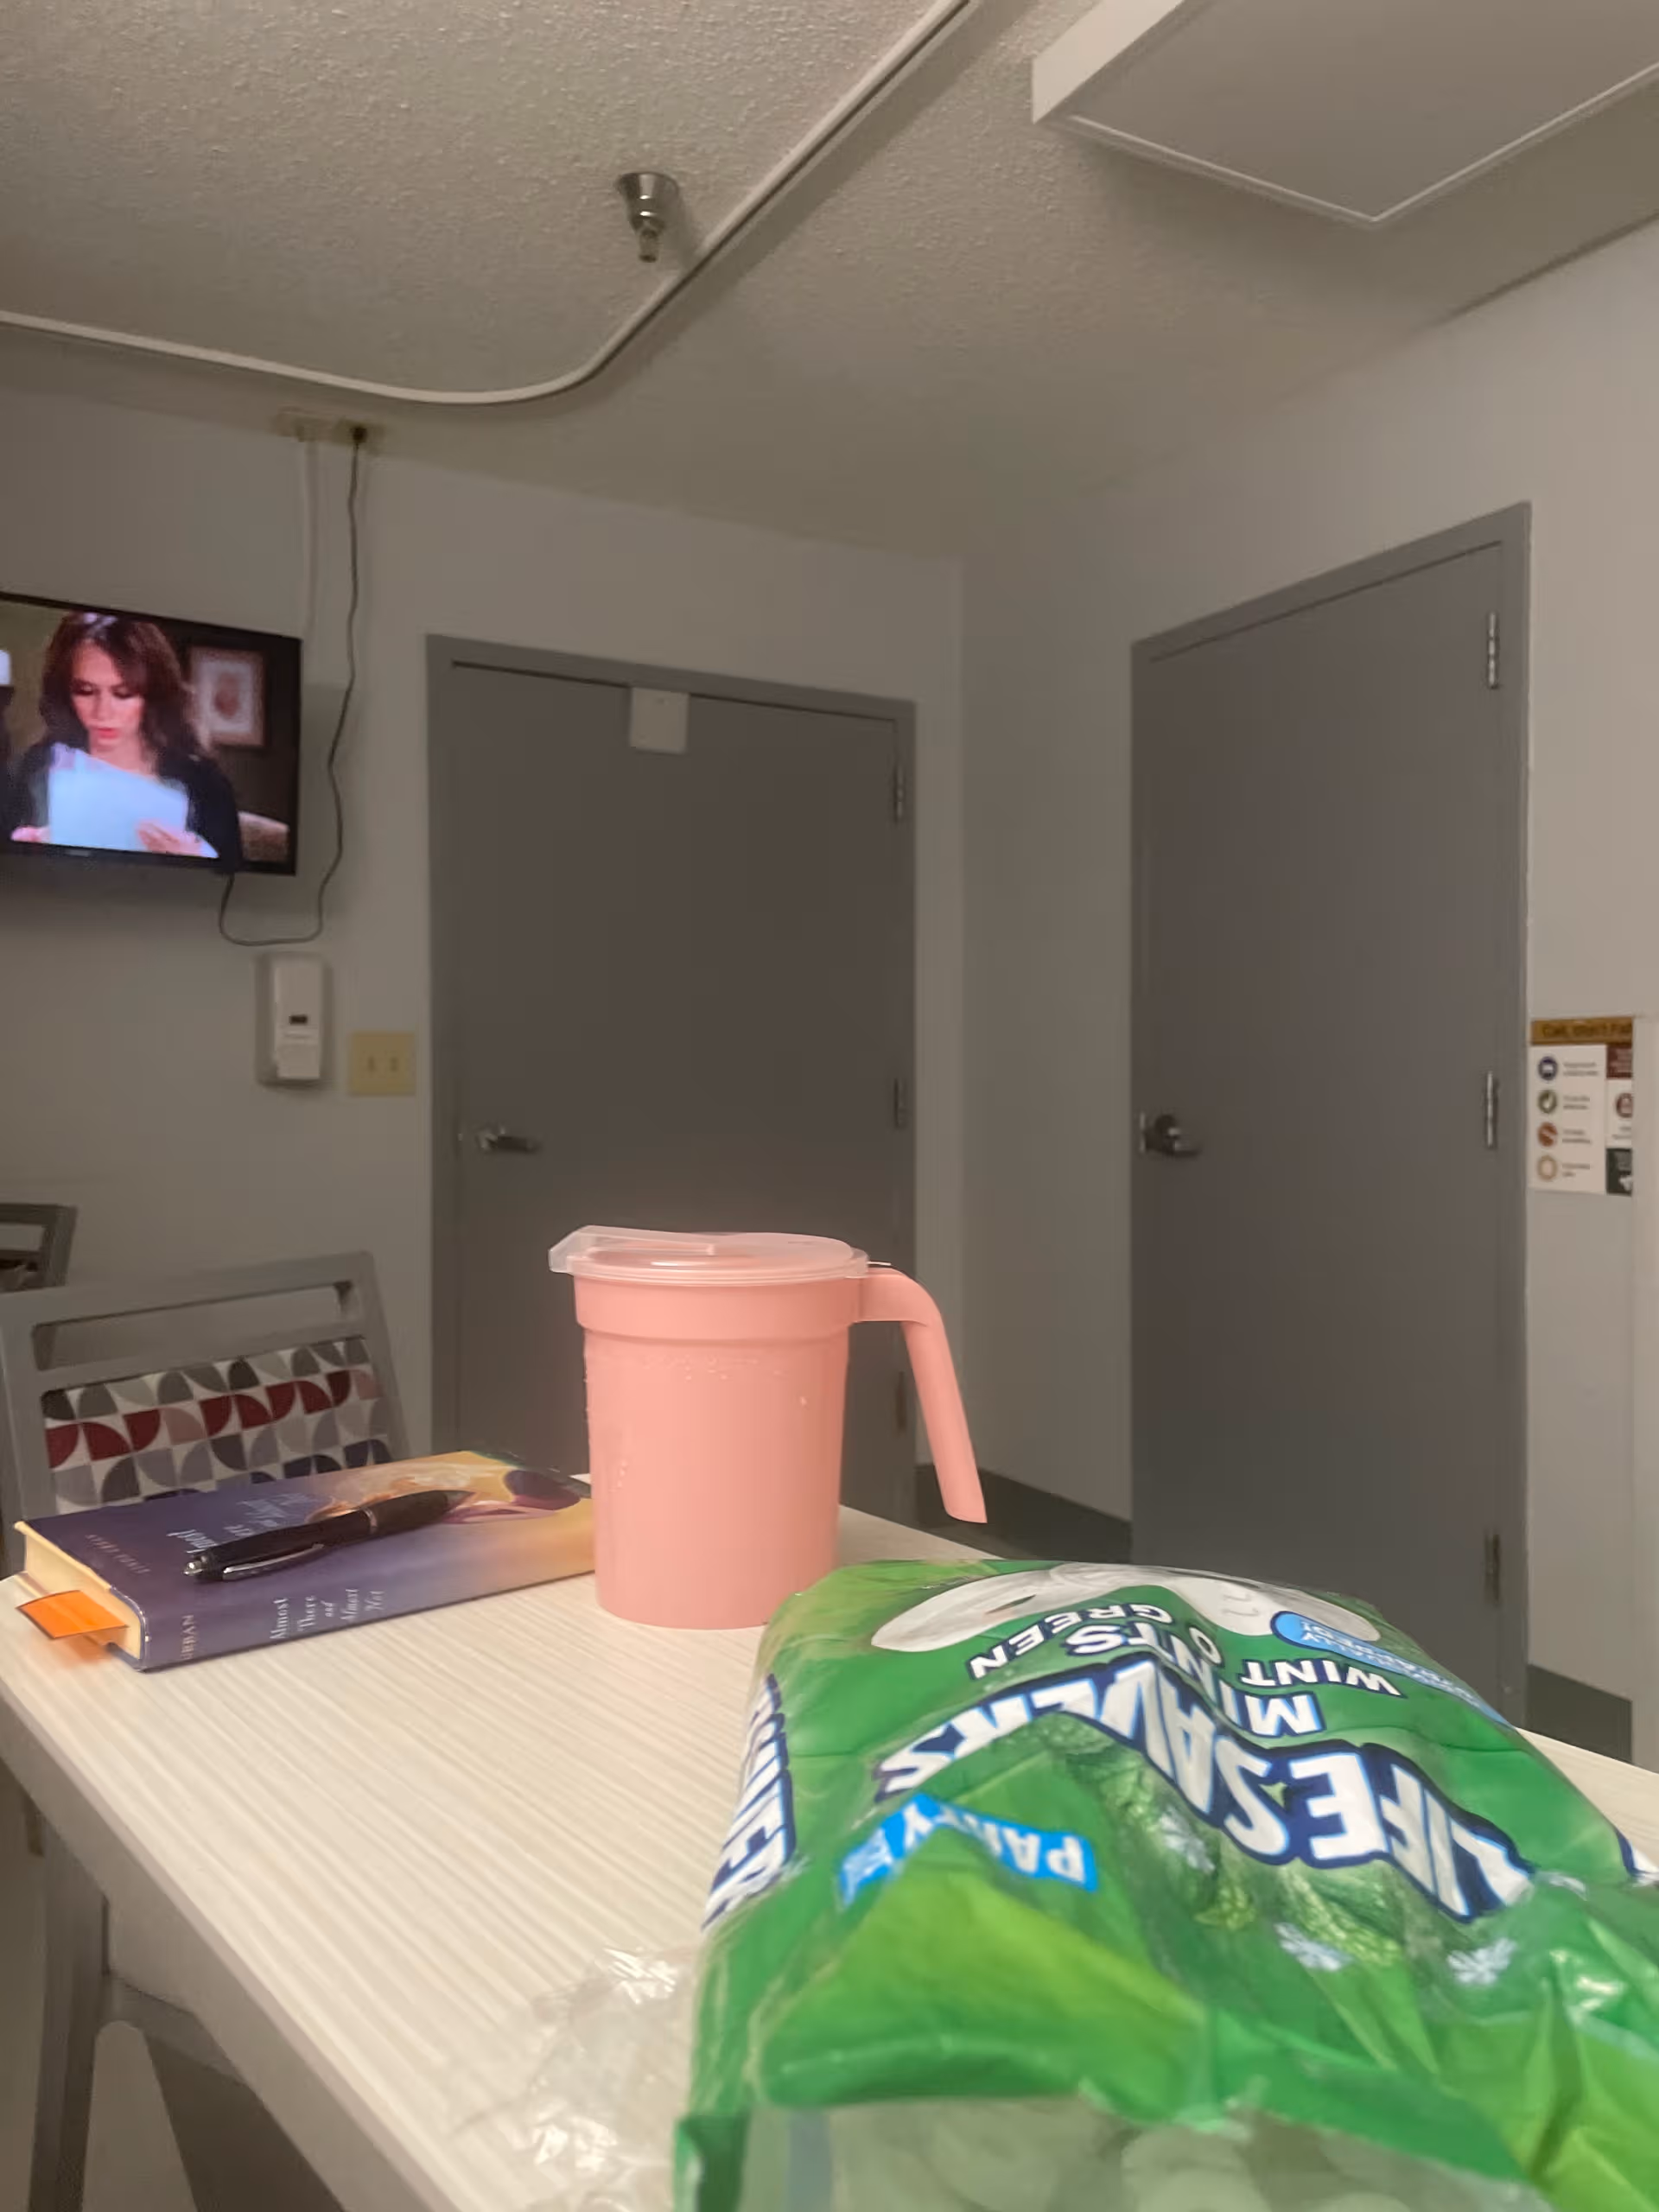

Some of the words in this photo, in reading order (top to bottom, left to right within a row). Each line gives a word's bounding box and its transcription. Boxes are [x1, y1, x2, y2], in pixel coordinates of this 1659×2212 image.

[270, 1597, 289, 1639] Almost
[297, 1595, 317, 1631] There
[321, 1600, 334, 1618] and
[970, 1604, 1173, 1679] GREEN
[1189, 1627, 1222, 1664] O
[1065, 1622, 1323, 1735] MINTS
[1242, 1660, 1402, 1696] WINT
